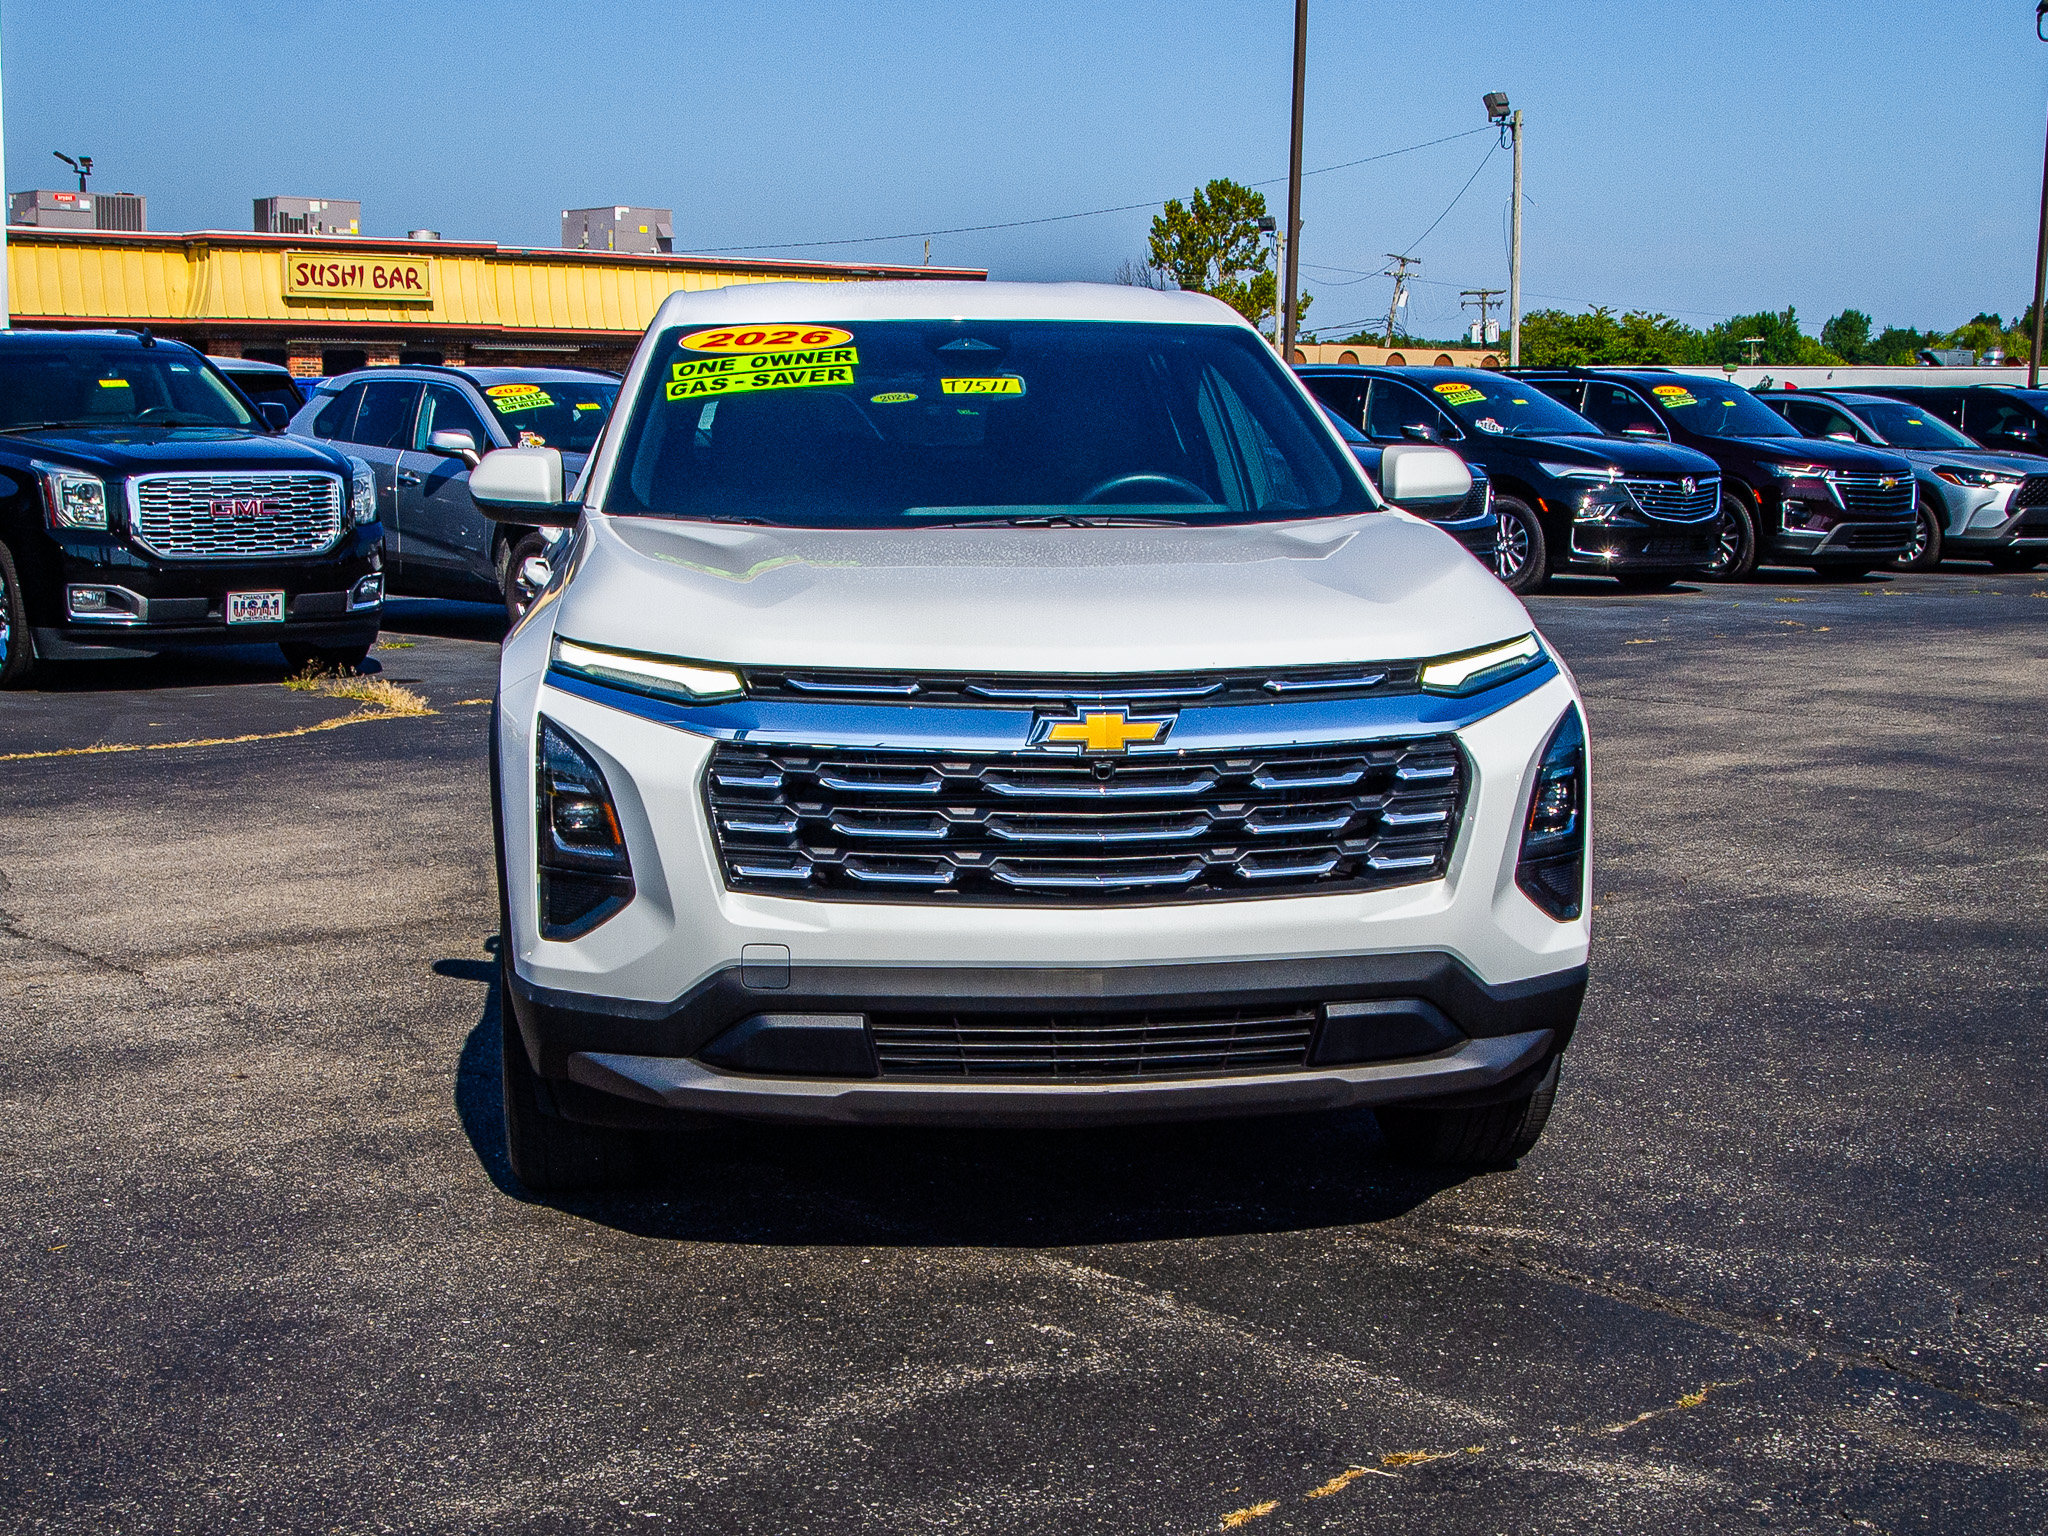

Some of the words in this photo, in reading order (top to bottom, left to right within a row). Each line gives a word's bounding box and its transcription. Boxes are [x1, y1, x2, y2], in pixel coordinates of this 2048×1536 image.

[296, 263, 364, 287] SUSHI
[373, 265, 422, 289] BAR
[699, 331, 834, 348] 2026
[678, 359, 737, 377] ONE
[751, 350, 852, 368] OWNER
[494, 386, 533, 395] 2025
[1439, 384, 1467, 392] 2024
[501, 393, 543, 406] SHARP
[879, 393, 911, 402] 2024
[500, 404, 518, 412] LOW
[518, 400, 551, 409] MILEAGE
[209, 498, 280, 517] GMC
